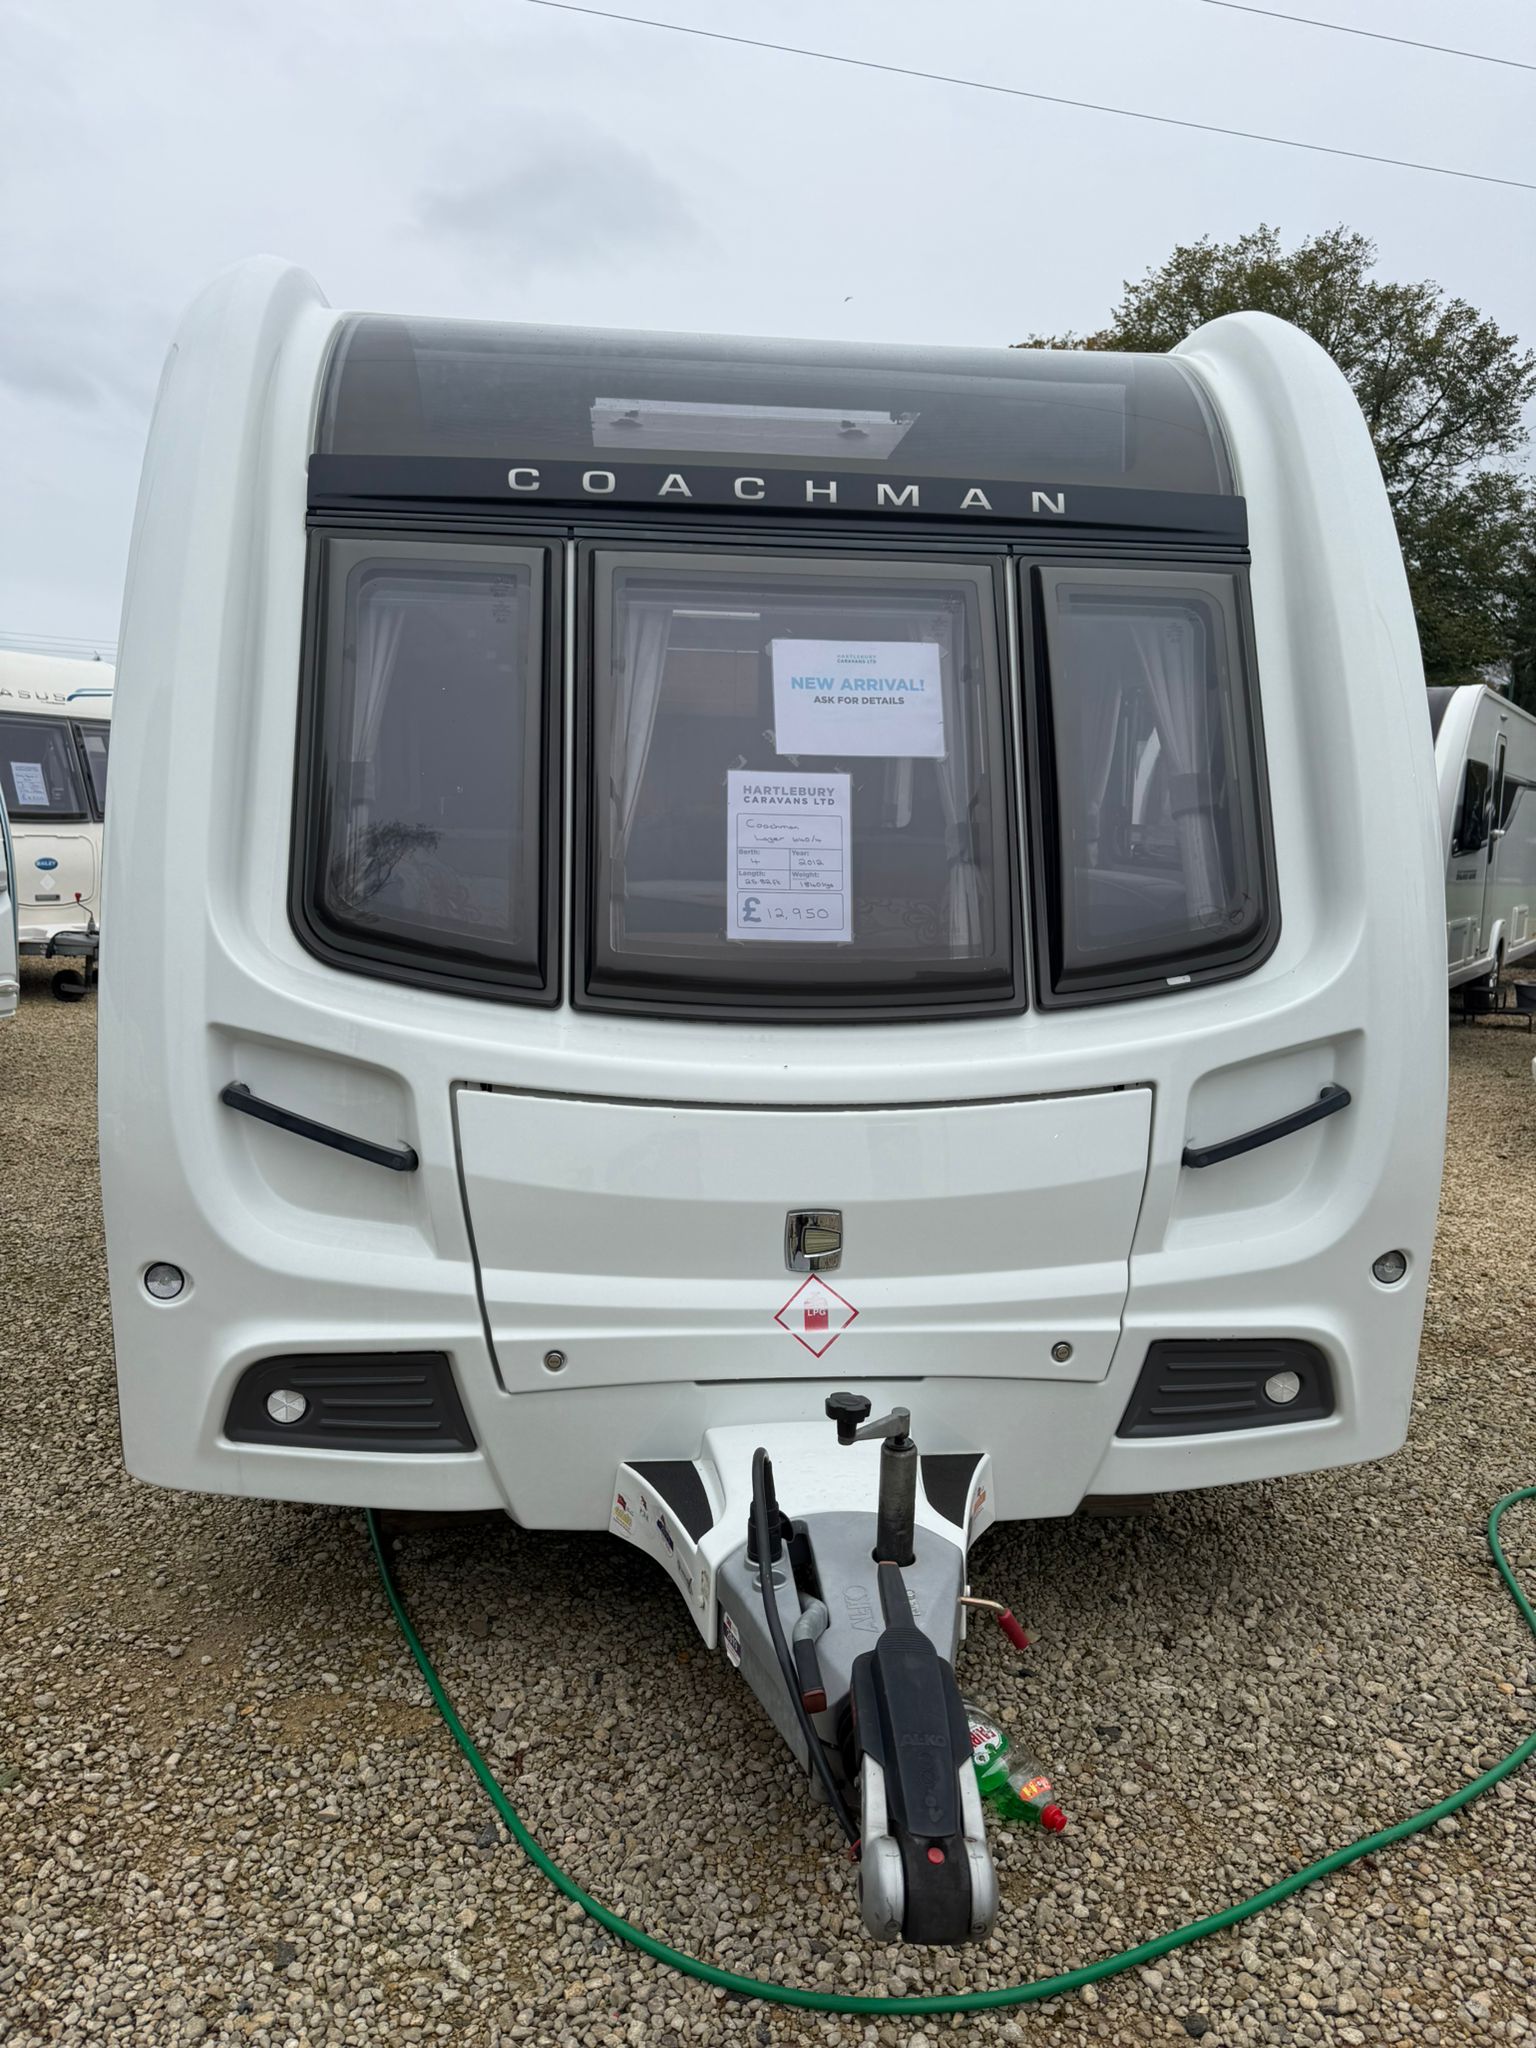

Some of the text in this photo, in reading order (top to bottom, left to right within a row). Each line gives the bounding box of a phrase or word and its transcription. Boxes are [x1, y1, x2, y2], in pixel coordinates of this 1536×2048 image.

[507, 467, 1067, 515] COACHMAN
[791, 676, 925, 692] NEW ARRIVAL!
[814, 695, 905, 705] ASK FOR DETAILS
[743, 785, 835, 797] HARTLEBURY
[743, 796, 835, 806] CARAVANS LTD
[738, 870, 766, 878] Length:
[791, 871, 820, 879] Weight:
[807, 1308, 827, 1317] LPG
